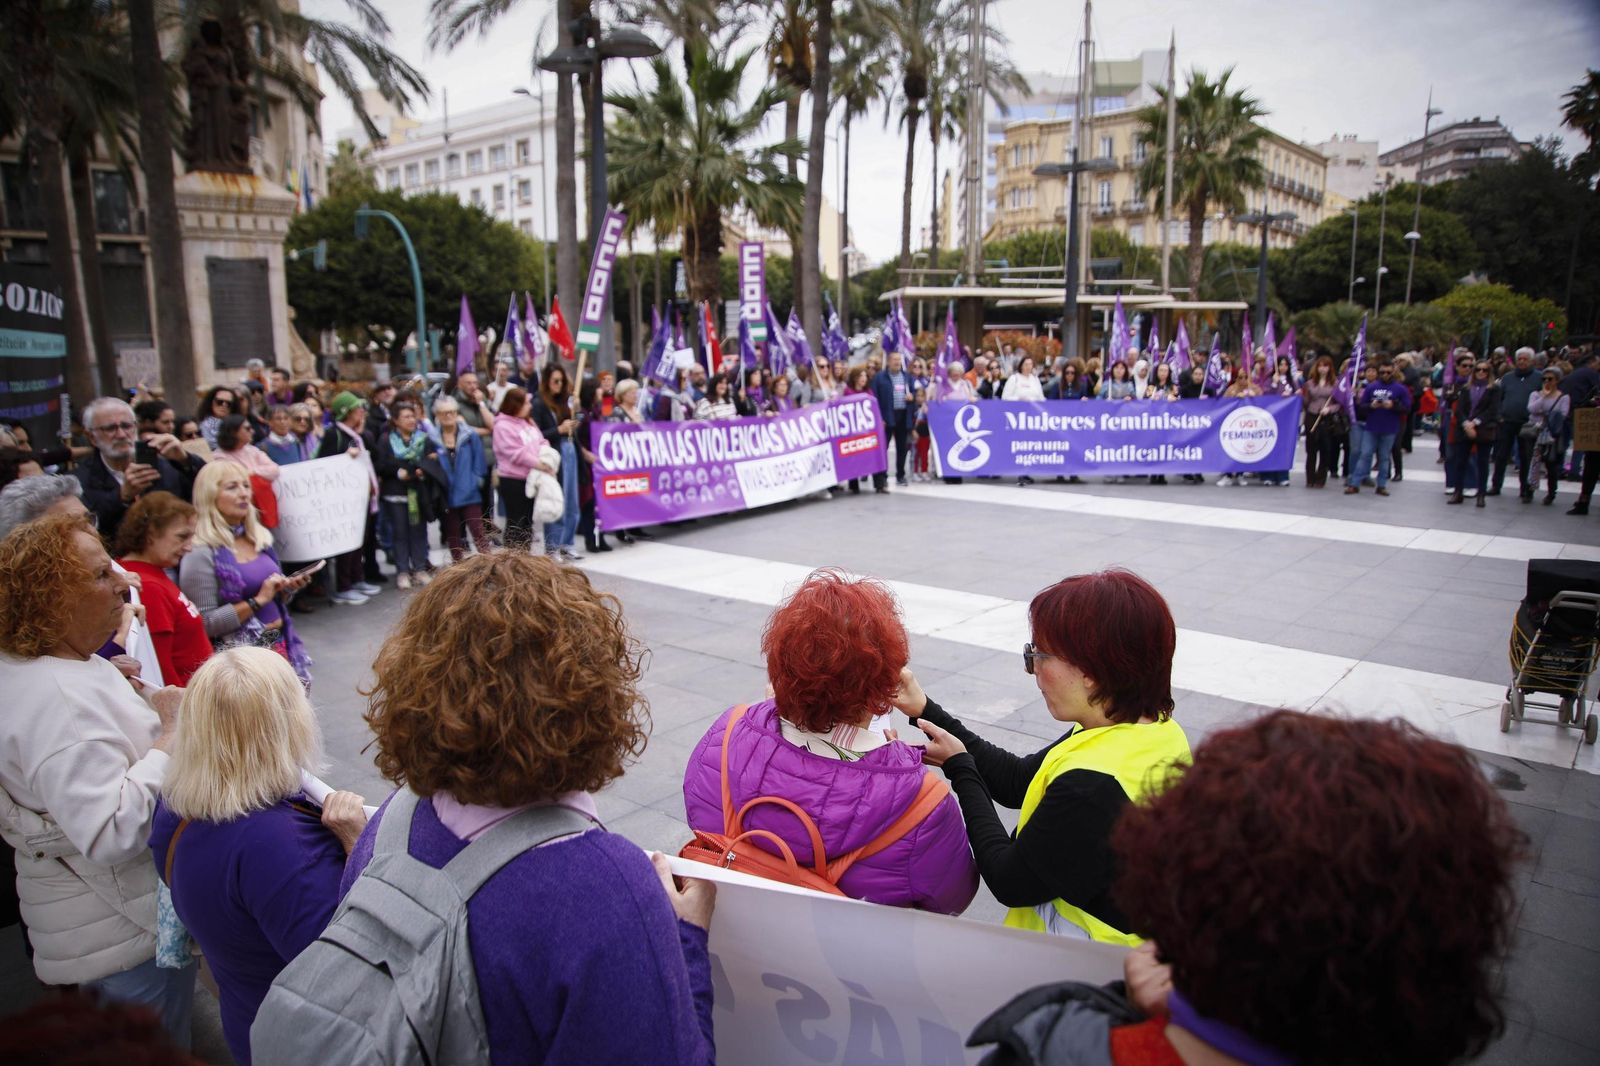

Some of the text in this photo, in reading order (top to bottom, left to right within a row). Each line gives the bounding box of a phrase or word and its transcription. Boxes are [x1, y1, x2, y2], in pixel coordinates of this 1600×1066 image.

[586, 217, 622, 321] CCOO
[743, 245, 762, 320] CCOO
[1005, 411, 1212, 431] Mujeres feministas
[1239, 419, 1258, 428] UGT
[599, 400, 876, 471] CONTRA LAS VIOLENCIAS MACHISTAS
[1222, 429, 1276, 440] FEMINISTA
[1011, 440, 1070, 453] para una
[1084, 444, 1203, 463] sindicalista
[1015, 452, 1064, 466] agenda
